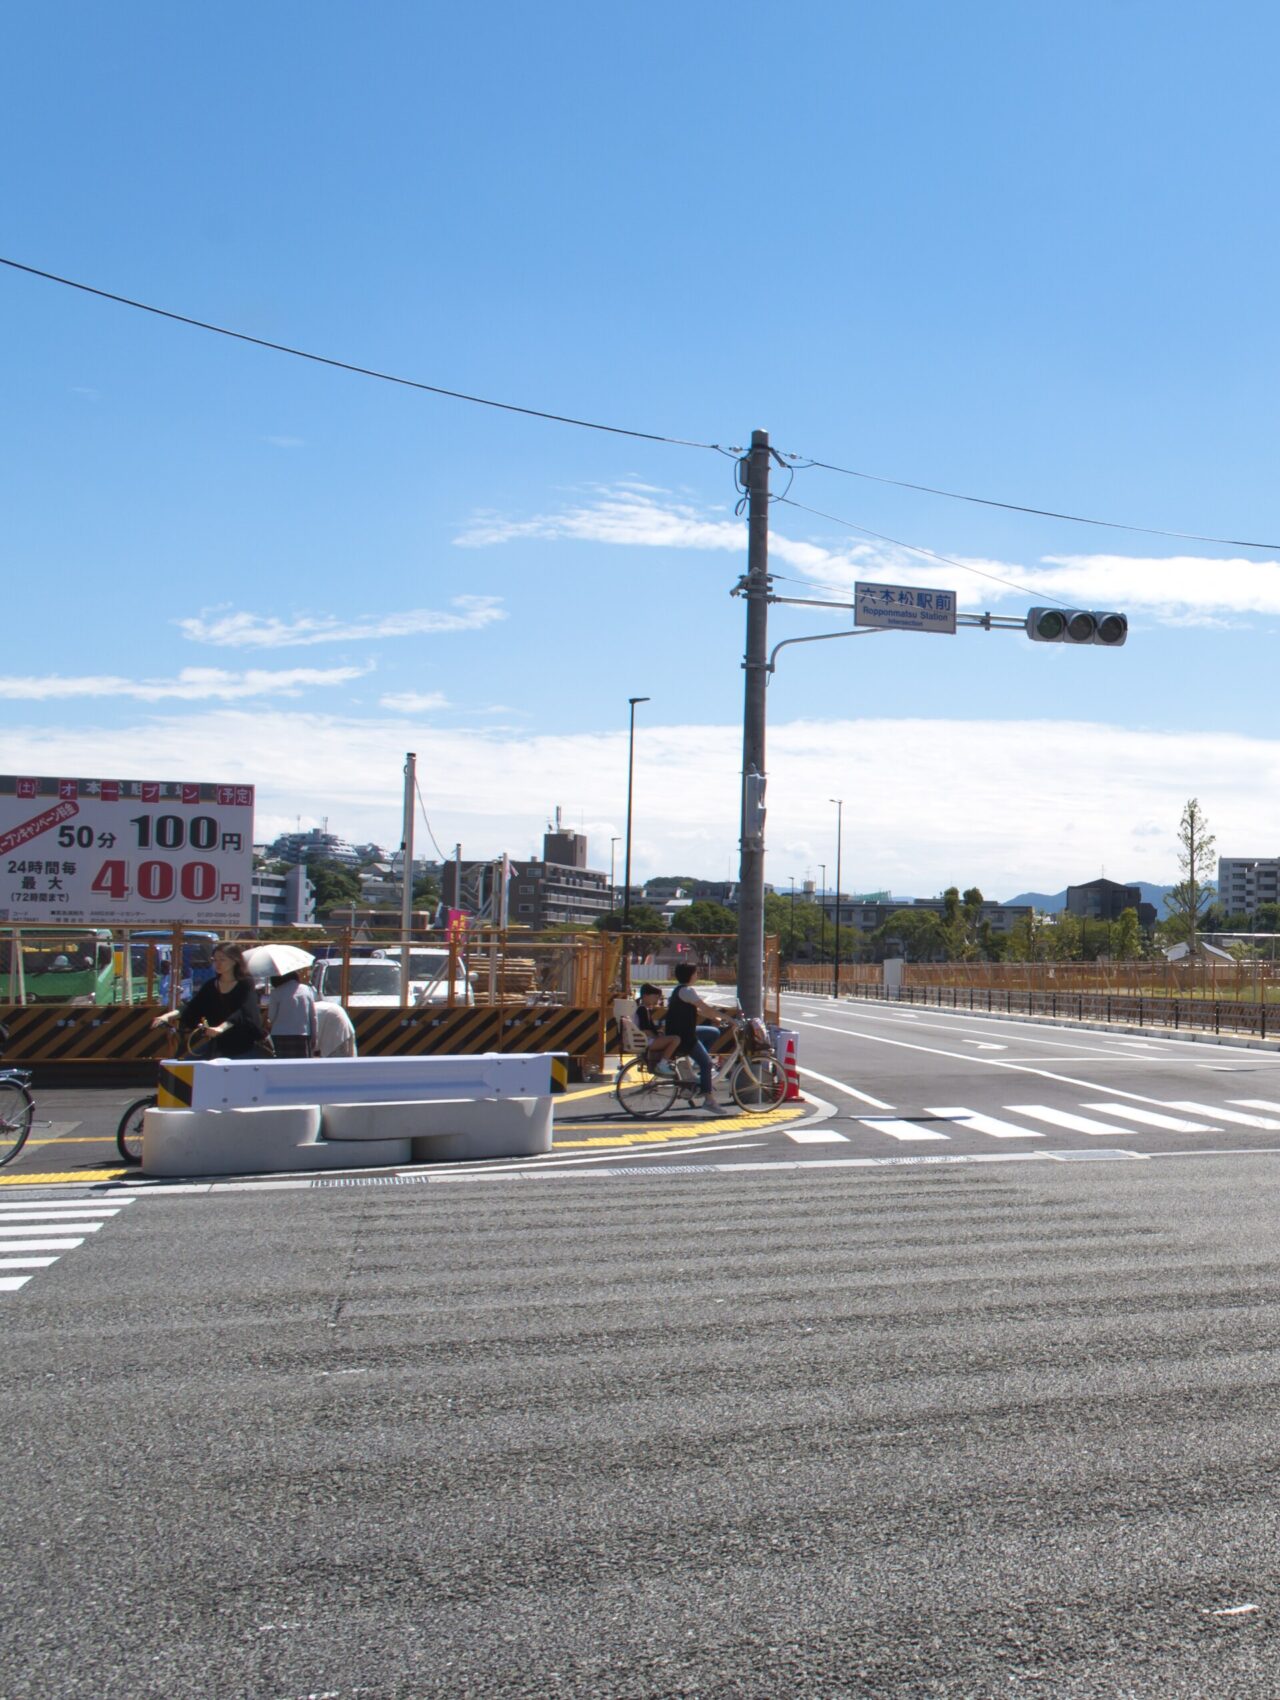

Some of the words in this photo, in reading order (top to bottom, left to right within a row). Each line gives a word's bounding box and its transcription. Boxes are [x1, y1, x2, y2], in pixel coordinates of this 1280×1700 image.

[859, 587, 951, 611] 六本松駅前
[920, 611, 948, 621] Station
[8, 860, 77, 876] 24時間毎
